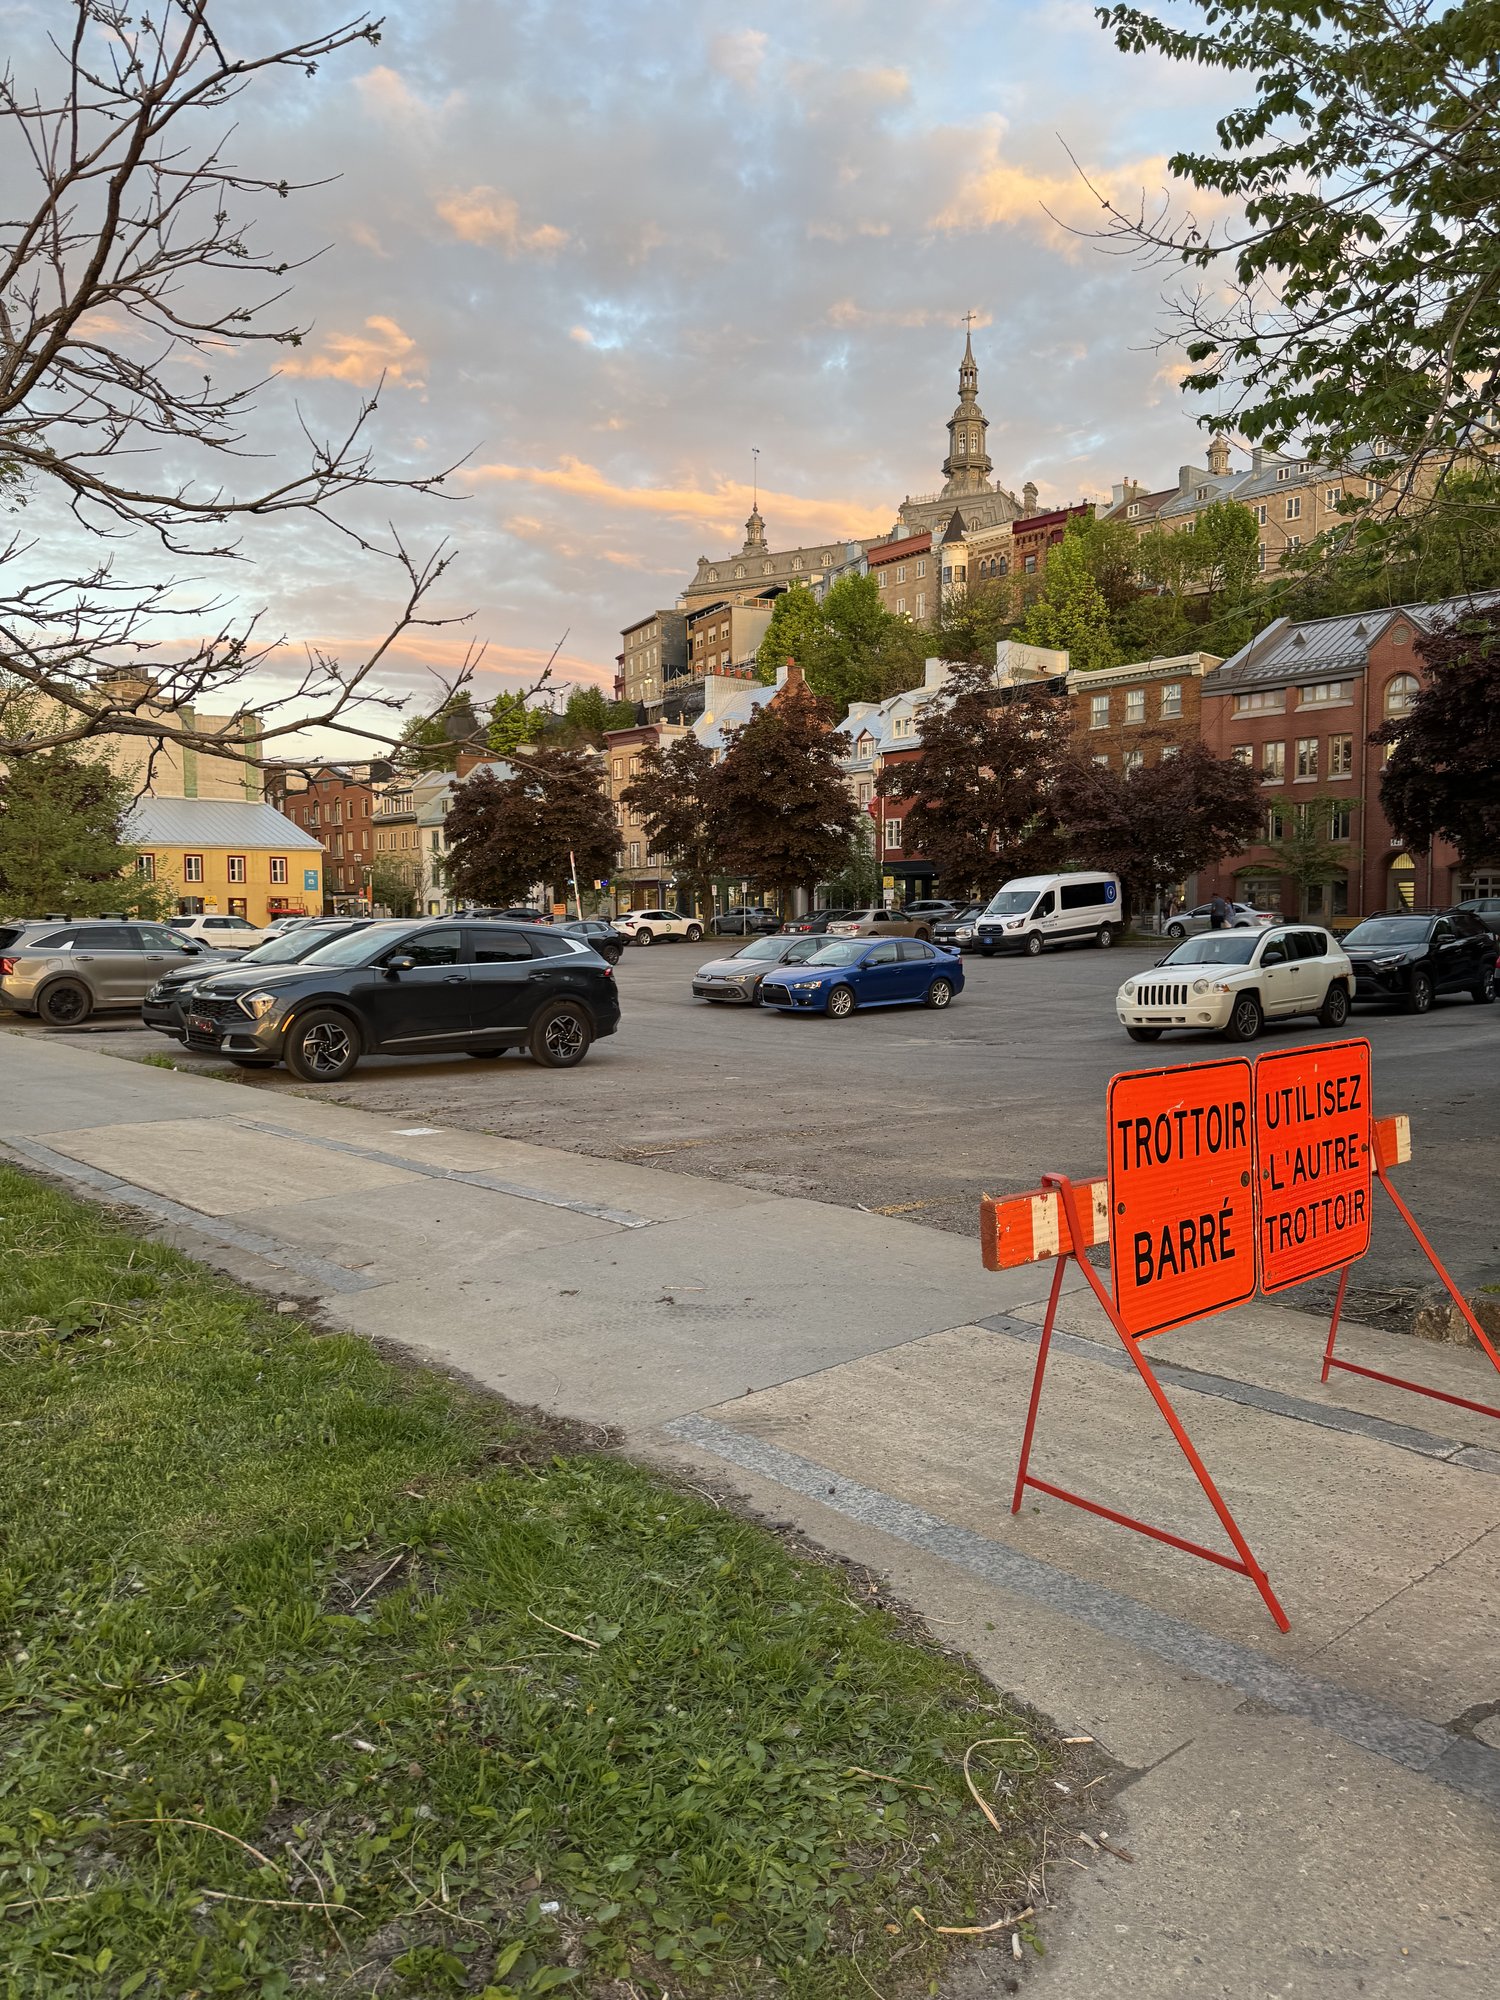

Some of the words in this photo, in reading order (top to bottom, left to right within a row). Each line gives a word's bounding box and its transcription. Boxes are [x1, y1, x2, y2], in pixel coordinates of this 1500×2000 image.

[1265, 1074, 1362, 1130] UTILISEZ
[1117, 1101, 1247, 1171] TROTTOIR
[1269, 1133, 1360, 1191] L'AUTRE
[1134, 1196, 1236, 1287] BARRÉ
[1264, 1189, 1365, 1254] TROTTOIR
